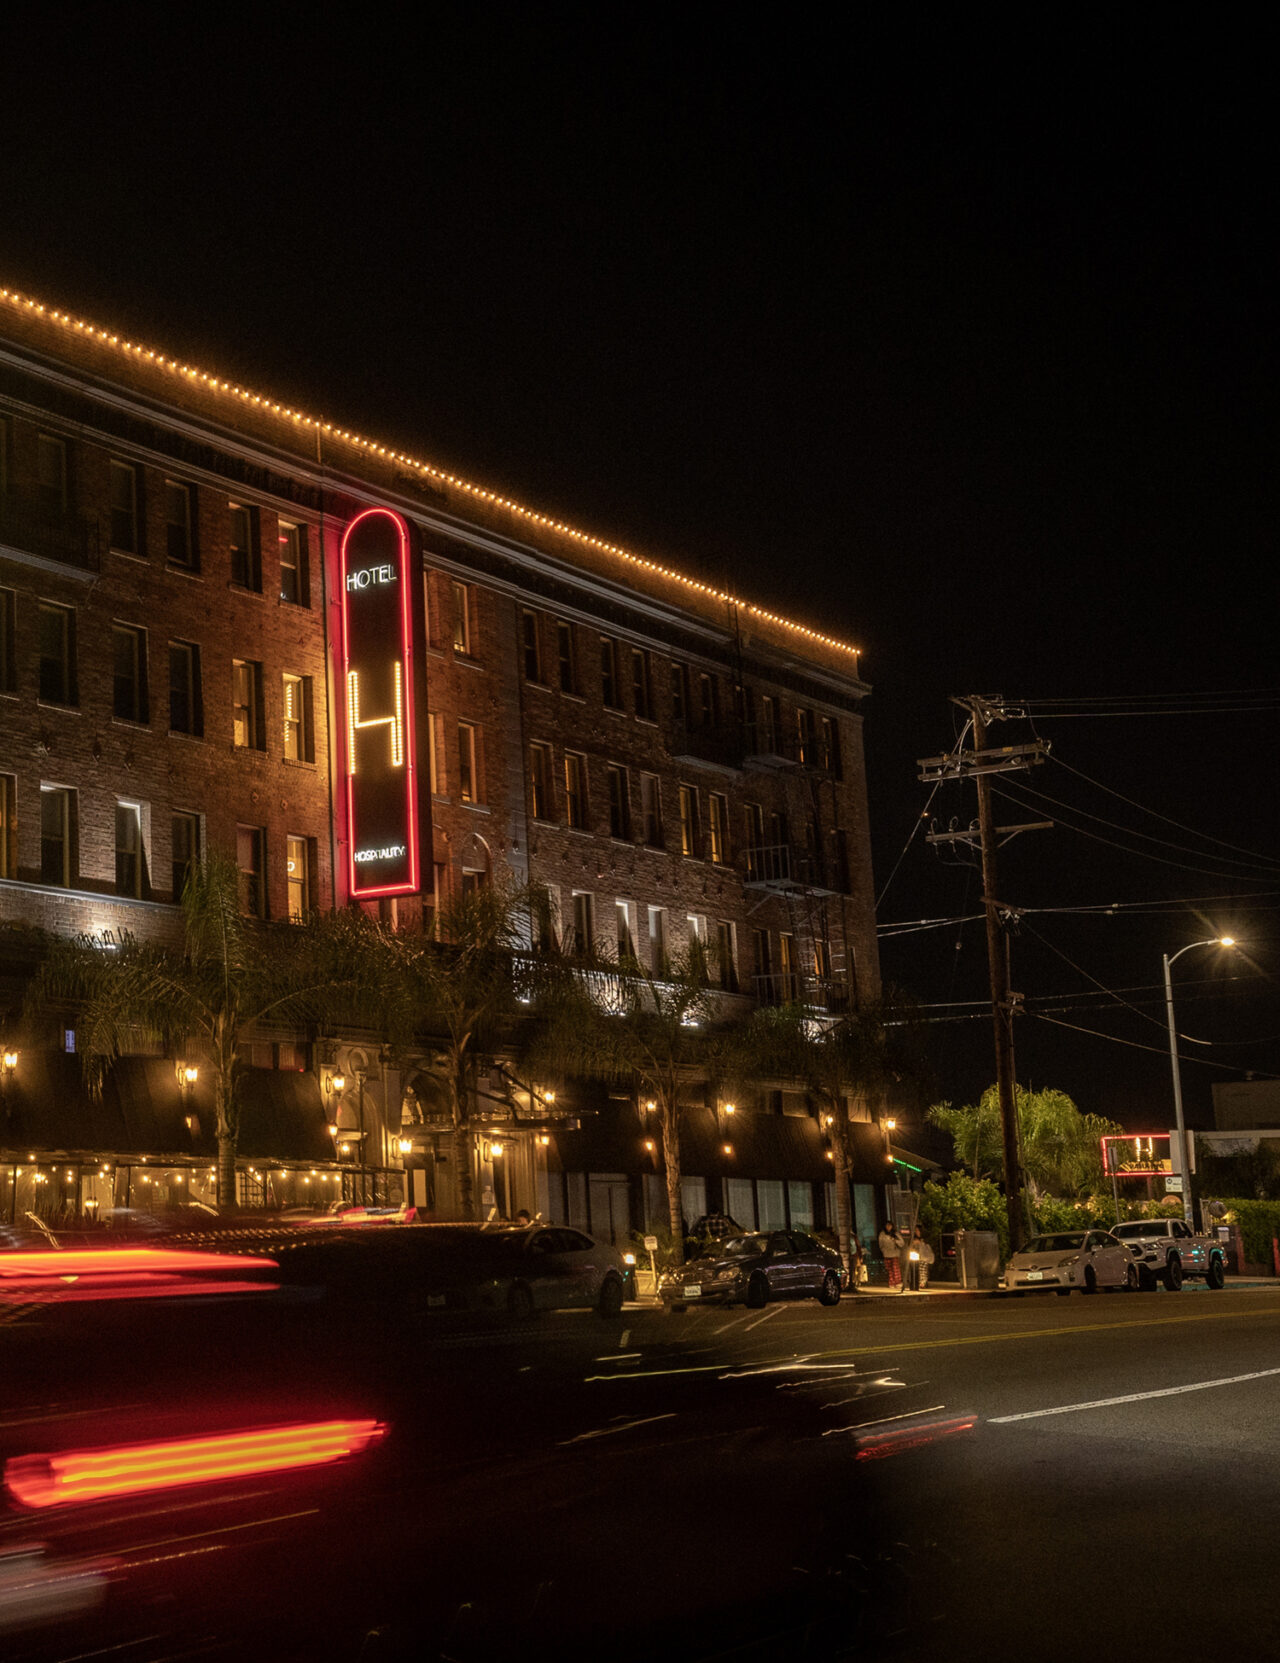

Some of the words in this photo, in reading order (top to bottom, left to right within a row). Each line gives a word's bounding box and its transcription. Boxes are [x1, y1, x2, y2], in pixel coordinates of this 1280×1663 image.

[346, 564, 398, 592] HOTEL
[347, 661, 403, 775] H
[354, 845, 405, 862] HOSPITALITY
